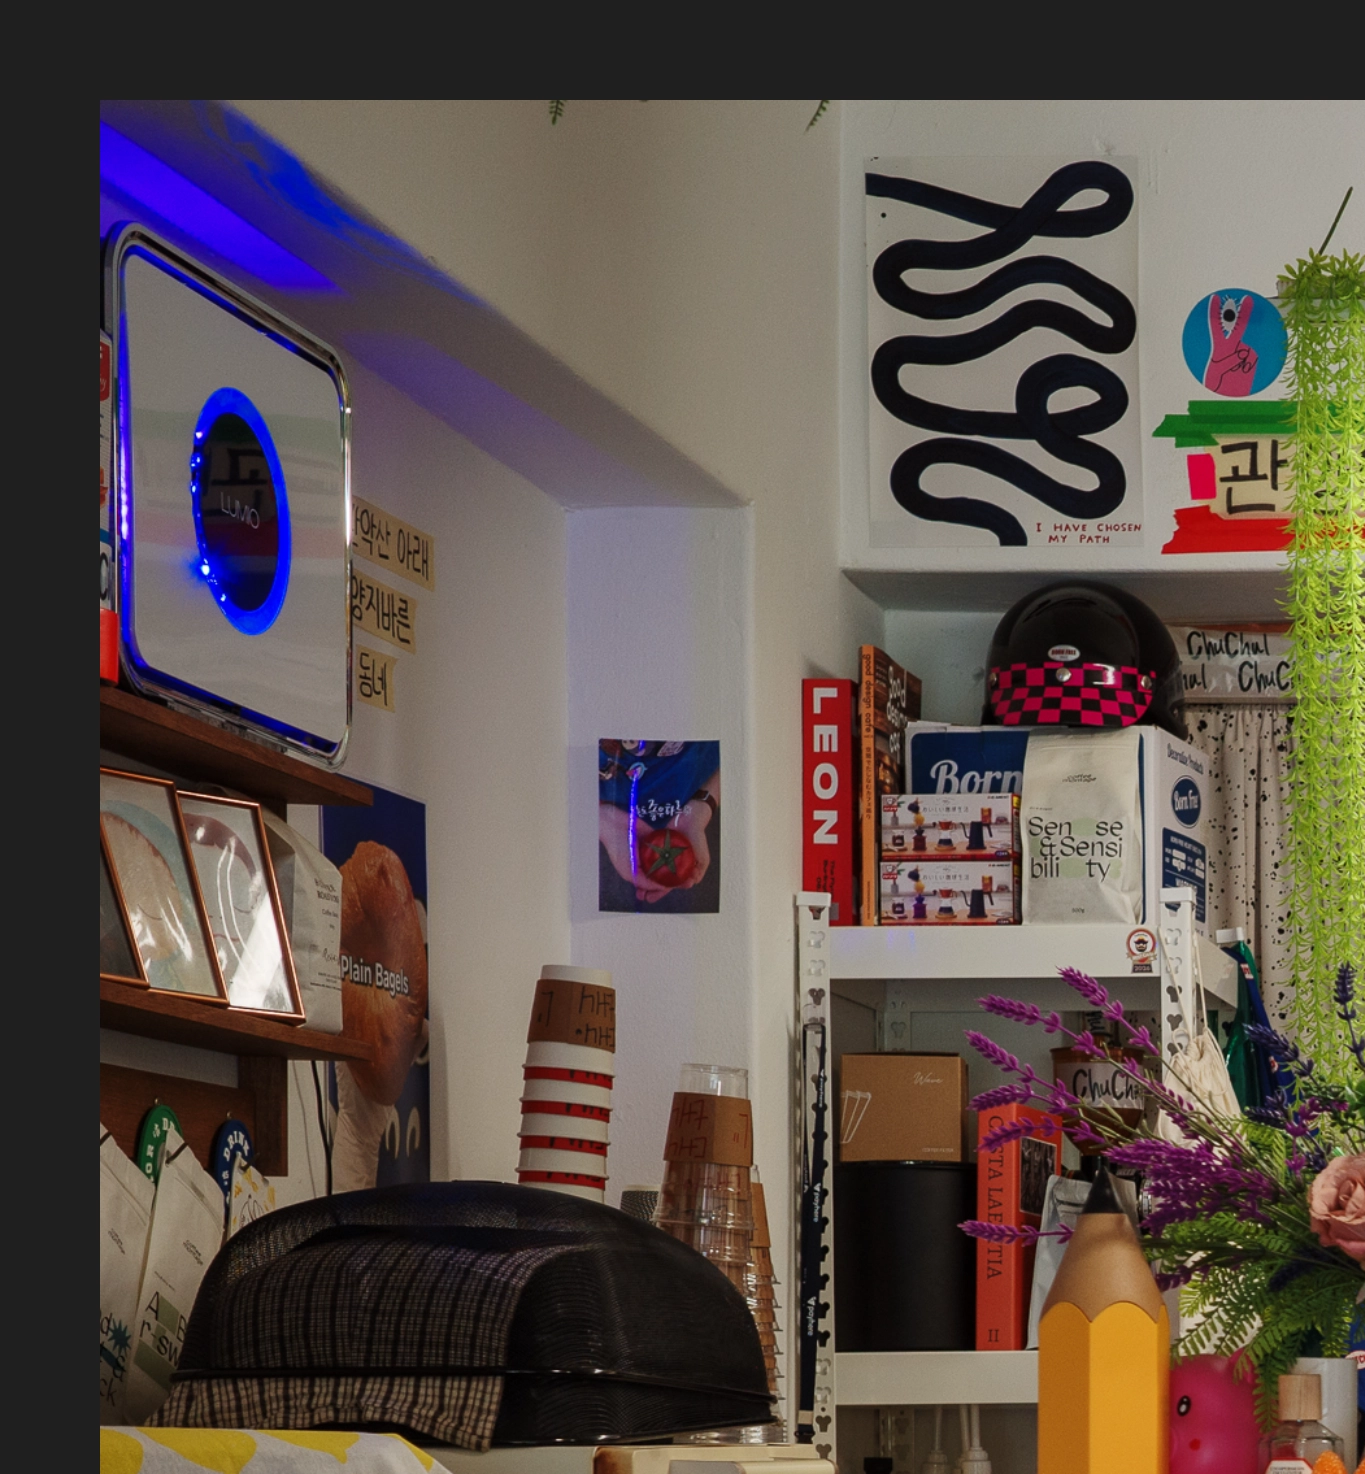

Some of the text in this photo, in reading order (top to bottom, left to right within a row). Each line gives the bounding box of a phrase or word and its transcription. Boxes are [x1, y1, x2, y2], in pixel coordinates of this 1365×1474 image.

[219, 491, 261, 530] LUMIO
[1035, 522, 1142, 533] I HAVE CHOSEN
[396, 528, 430, 582] 아래
[1048, 533, 1111, 545] MY PATH
[351, 574, 411, 645] 양지바른
[359, 651, 389, 707] 동네
[862, 652, 873, 733] good design cafe
[811, 686, 839, 845] LEON
[340, 954, 409, 997] Plain Bagels
[986, 1187, 1004, 1280] LAETIA
